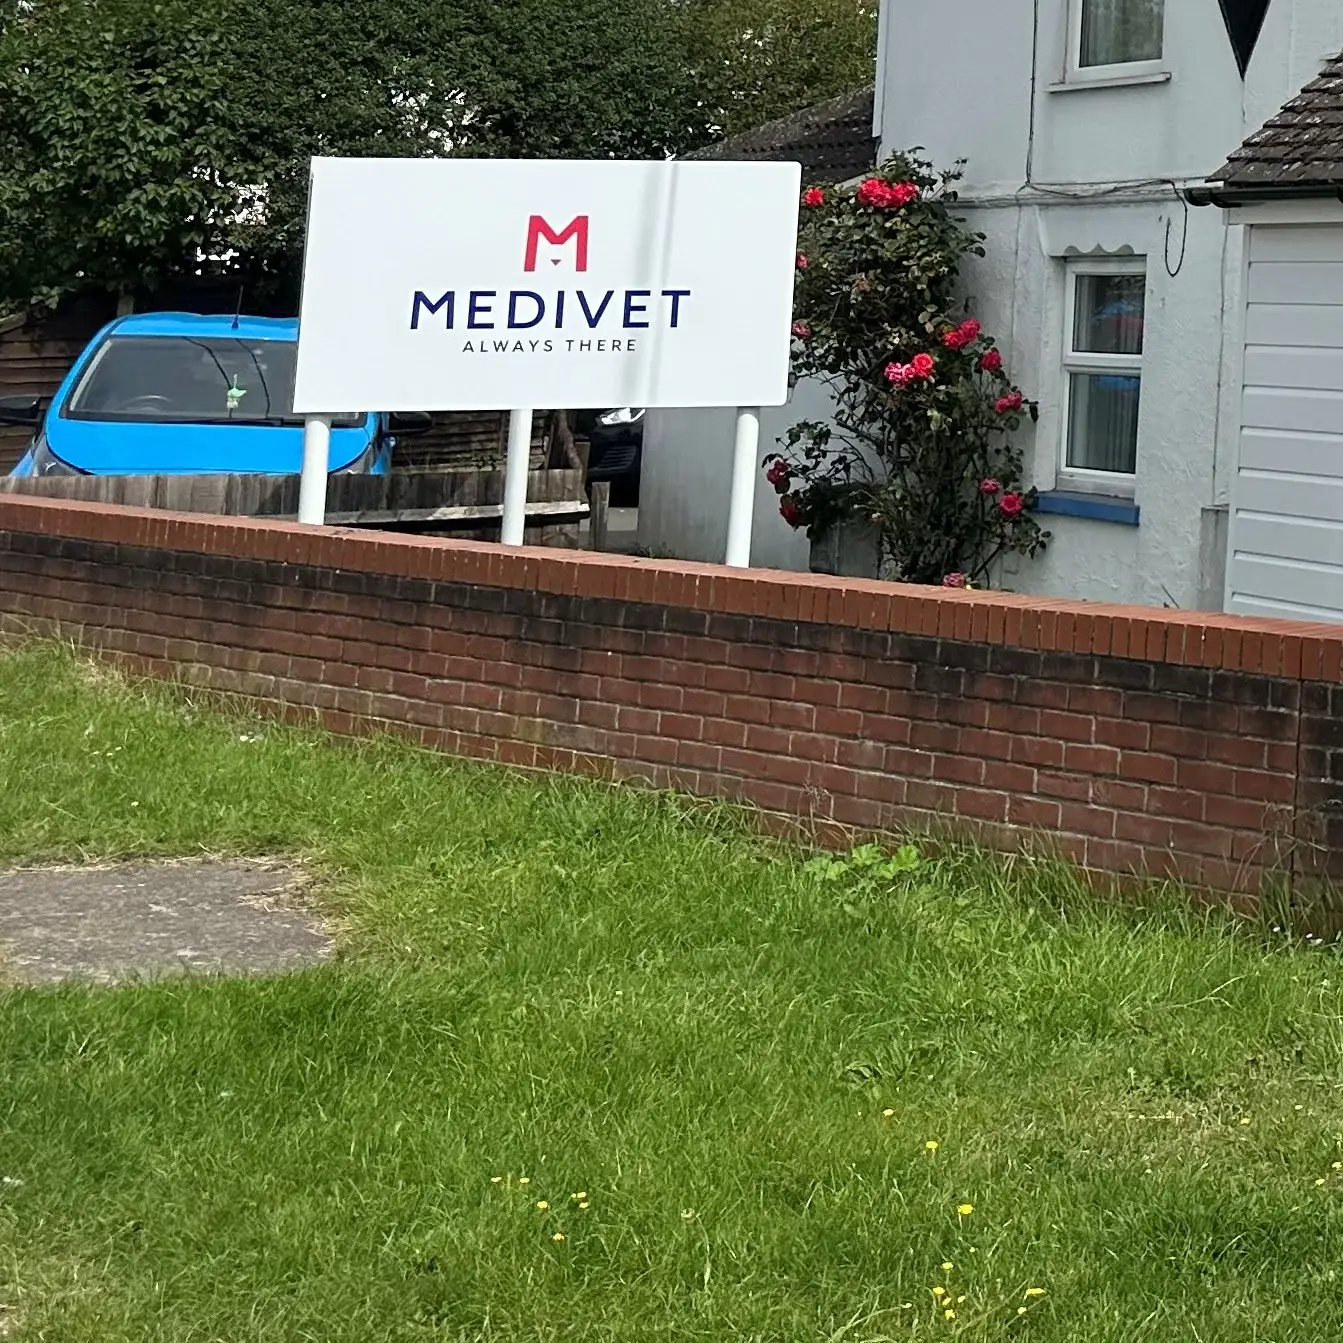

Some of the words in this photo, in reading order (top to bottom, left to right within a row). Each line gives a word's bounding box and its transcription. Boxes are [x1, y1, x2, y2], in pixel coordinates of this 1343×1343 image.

[523, 215, 589, 272] M
[409, 289, 691, 330] MEDIVET
[462, 339, 554, 353] ALWAYS
[565, 339, 637, 352] THERE
